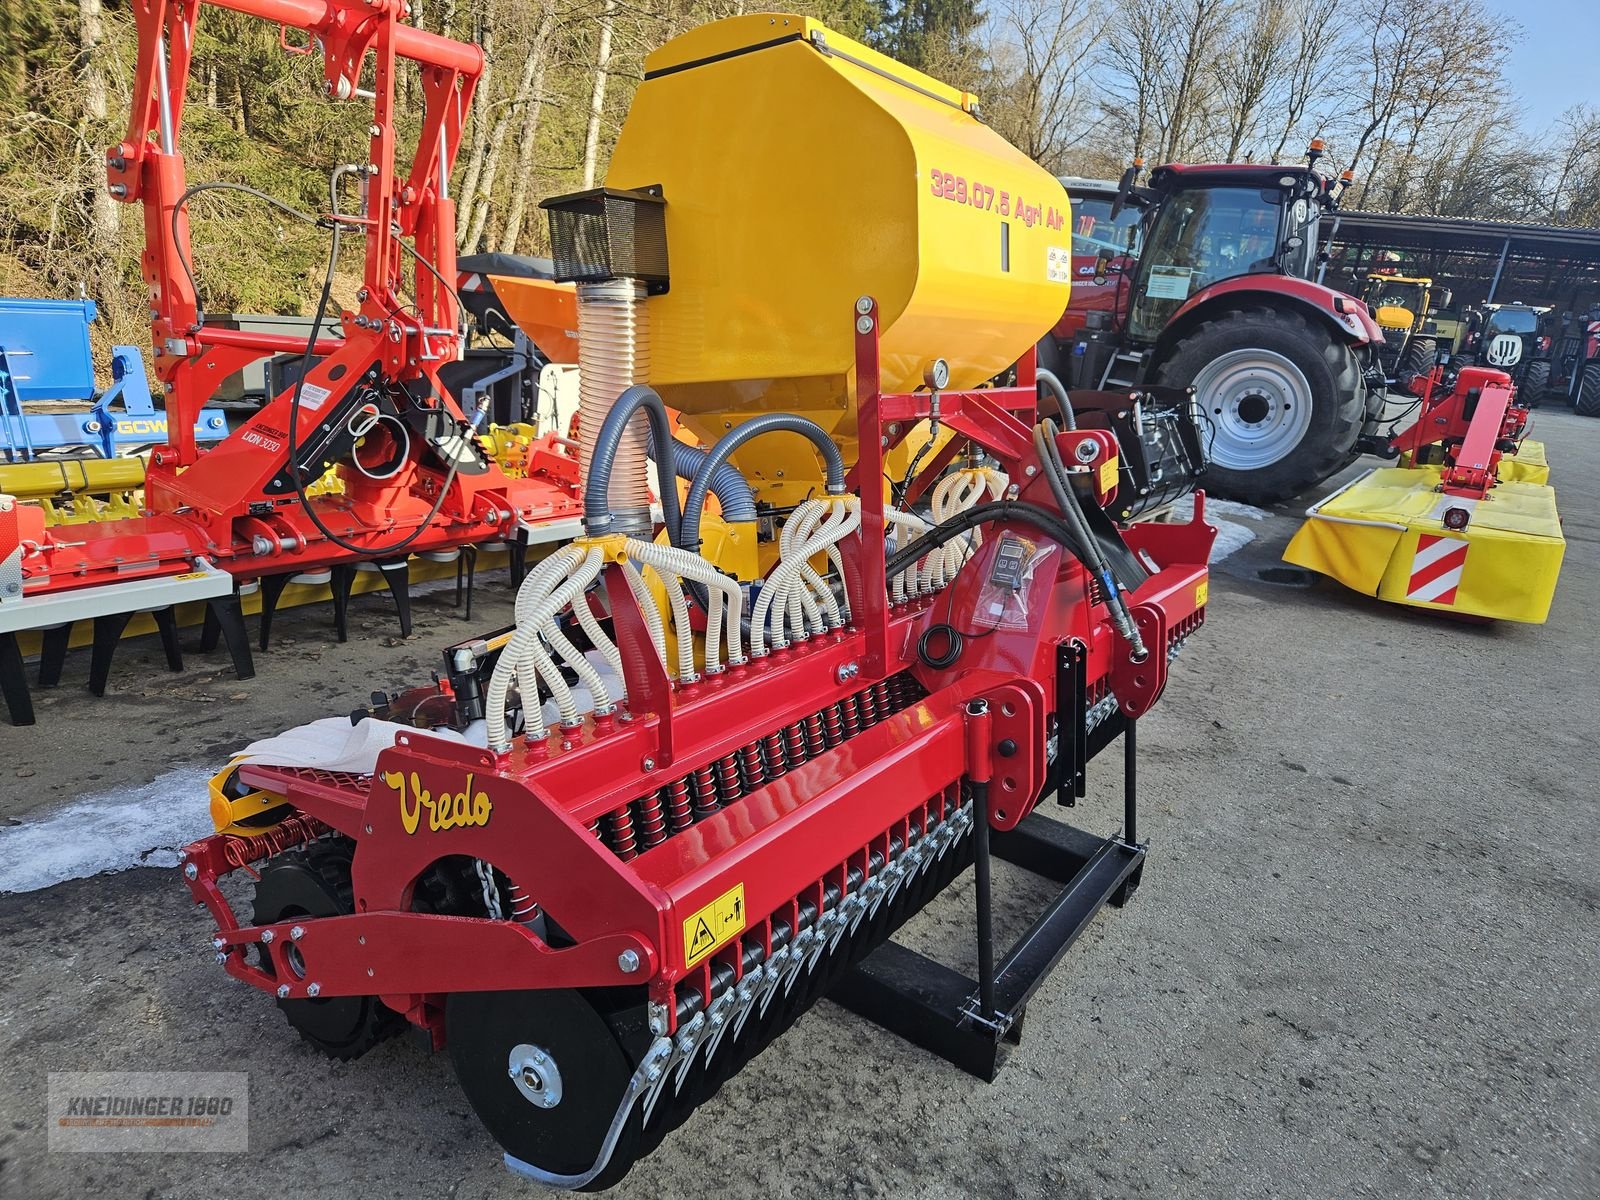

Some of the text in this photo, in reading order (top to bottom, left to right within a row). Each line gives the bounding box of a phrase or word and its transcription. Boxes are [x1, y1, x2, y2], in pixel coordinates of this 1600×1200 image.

[930, 168, 1065, 231] 329.07.5 Agri Air
[241, 431, 263, 445] LION
[259, 437, 281, 453] 3030
[385, 770, 493, 835] Vredo
